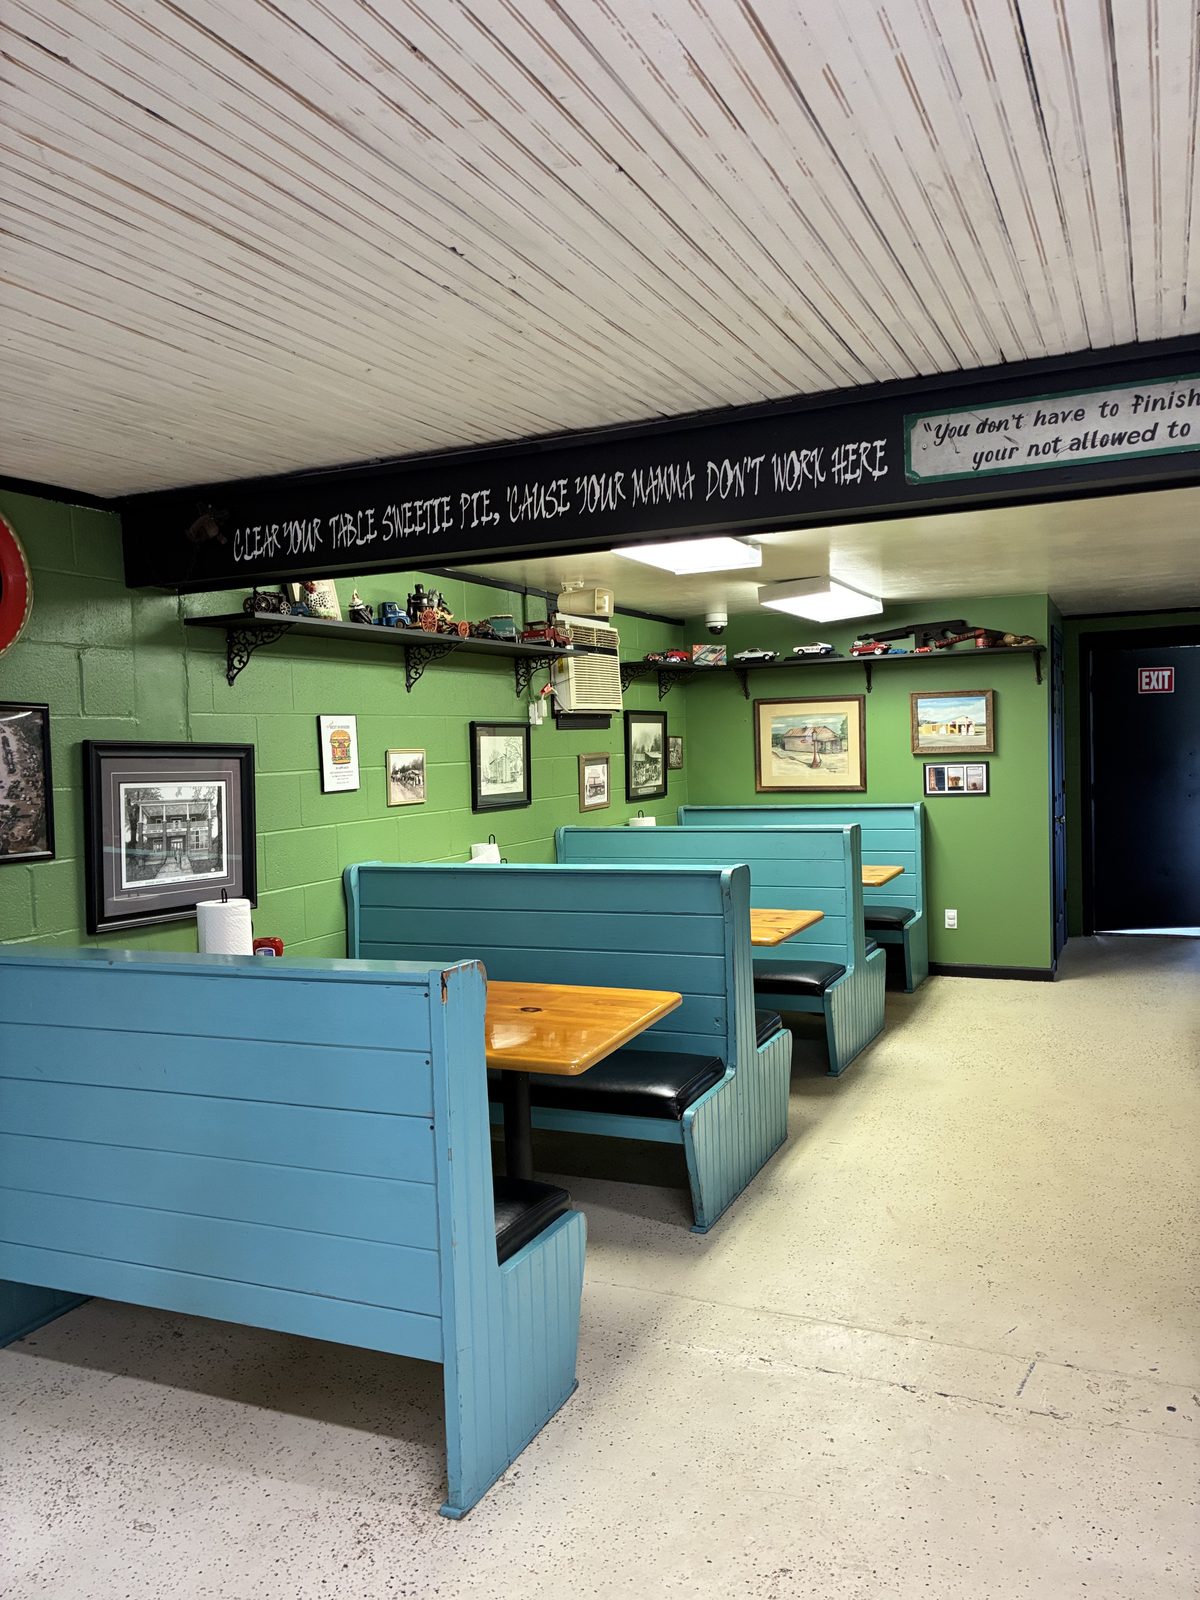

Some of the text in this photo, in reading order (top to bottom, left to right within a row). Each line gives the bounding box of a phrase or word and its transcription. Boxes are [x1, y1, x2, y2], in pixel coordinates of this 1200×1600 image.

[976, 412, 1025, 435] don't
[1033, 409, 1086, 427] have
[1099, 400, 1120, 419] to
[1131, 388, 1200, 414] finish
[972, 420, 1191, 471] your not allowed to
[233, 438, 889, 562] CLEAR YOUR TABLE SWEETIE PIE, 'CAUSE YOUR MAMMA DON'T WORK HERE
[1142, 671, 1171, 690] EXIT
